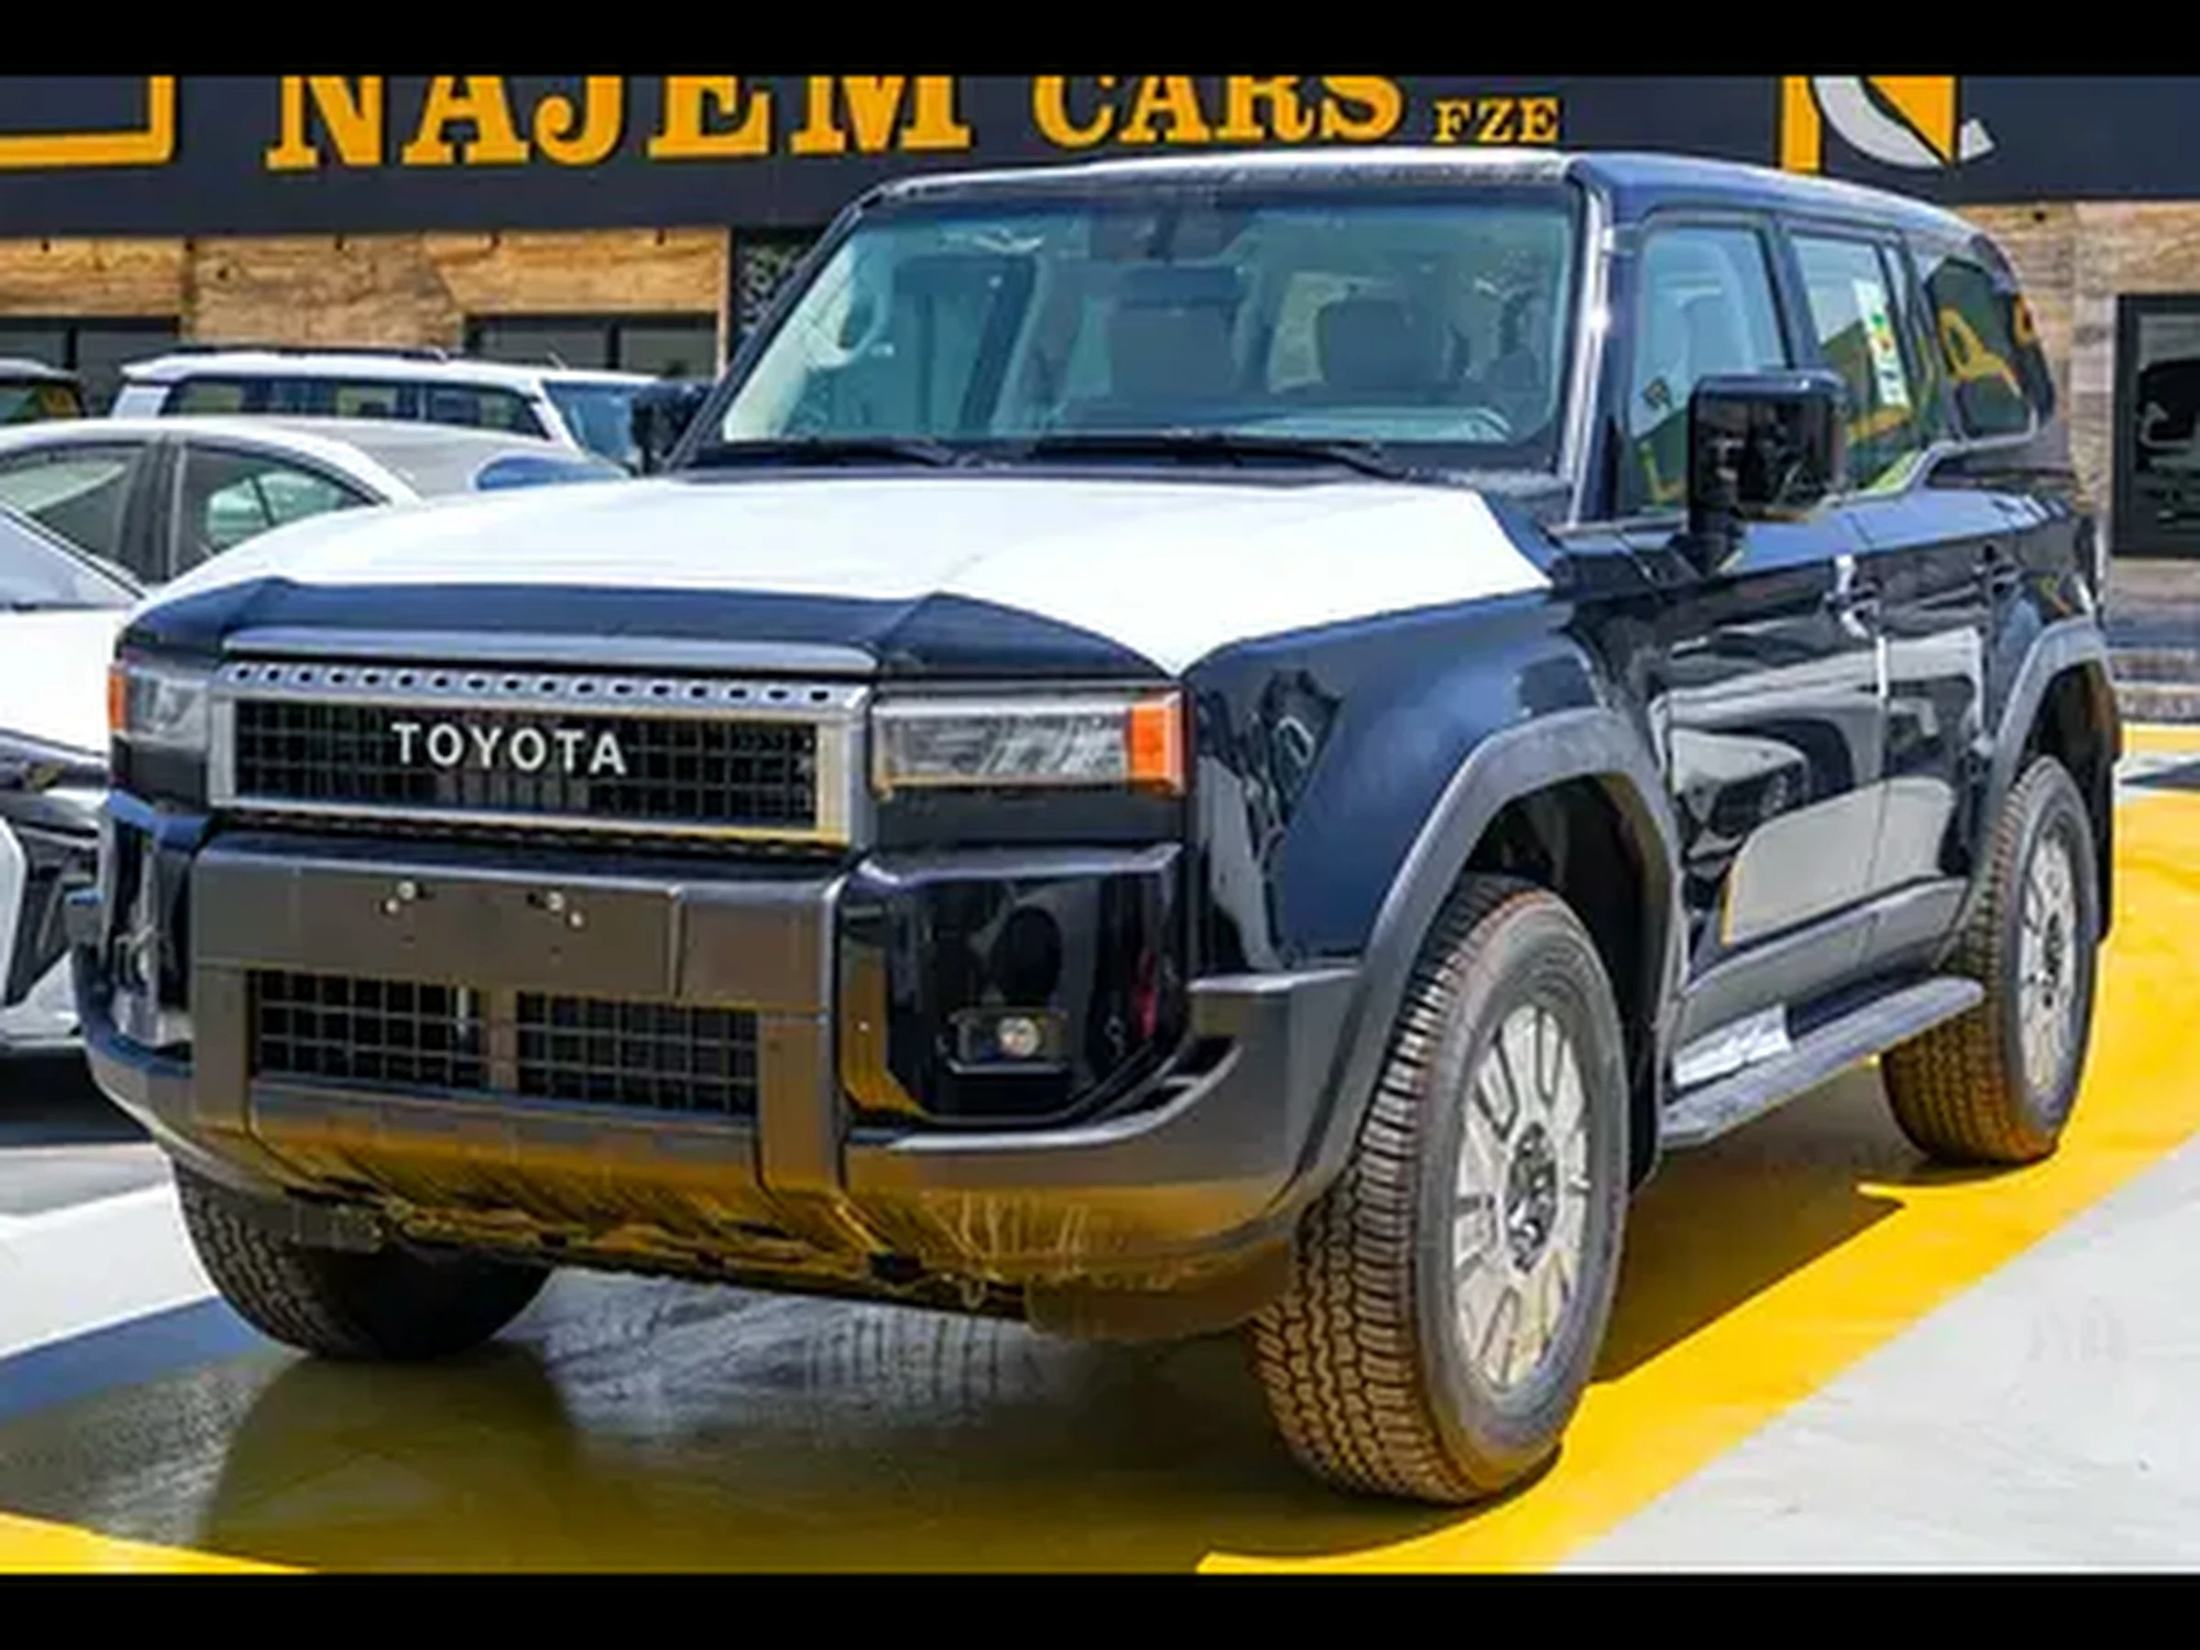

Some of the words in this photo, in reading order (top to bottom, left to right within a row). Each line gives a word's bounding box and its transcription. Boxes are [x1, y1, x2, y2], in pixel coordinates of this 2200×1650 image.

[266, 76, 970, 168] NAJEM
[1032, 76, 1404, 147] CARS
[1434, 97, 1558, 144] FZE
[391, 722, 627, 775] TOYOTA
